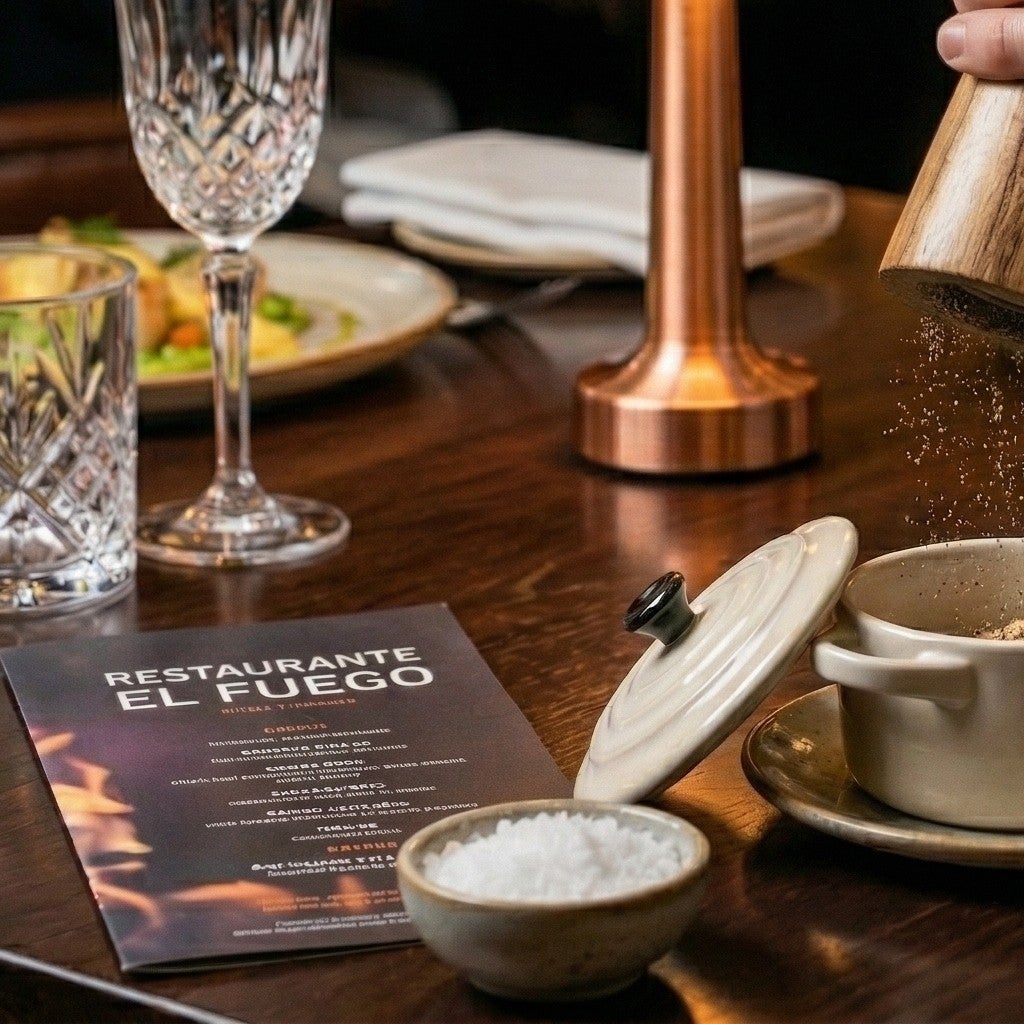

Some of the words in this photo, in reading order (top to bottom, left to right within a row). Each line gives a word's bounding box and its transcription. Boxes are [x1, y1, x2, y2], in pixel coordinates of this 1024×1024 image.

[104, 647, 421, 687] RESTAURANTE
[116, 687, 199, 711] EL
[217, 666, 434, 703] FUEGO
